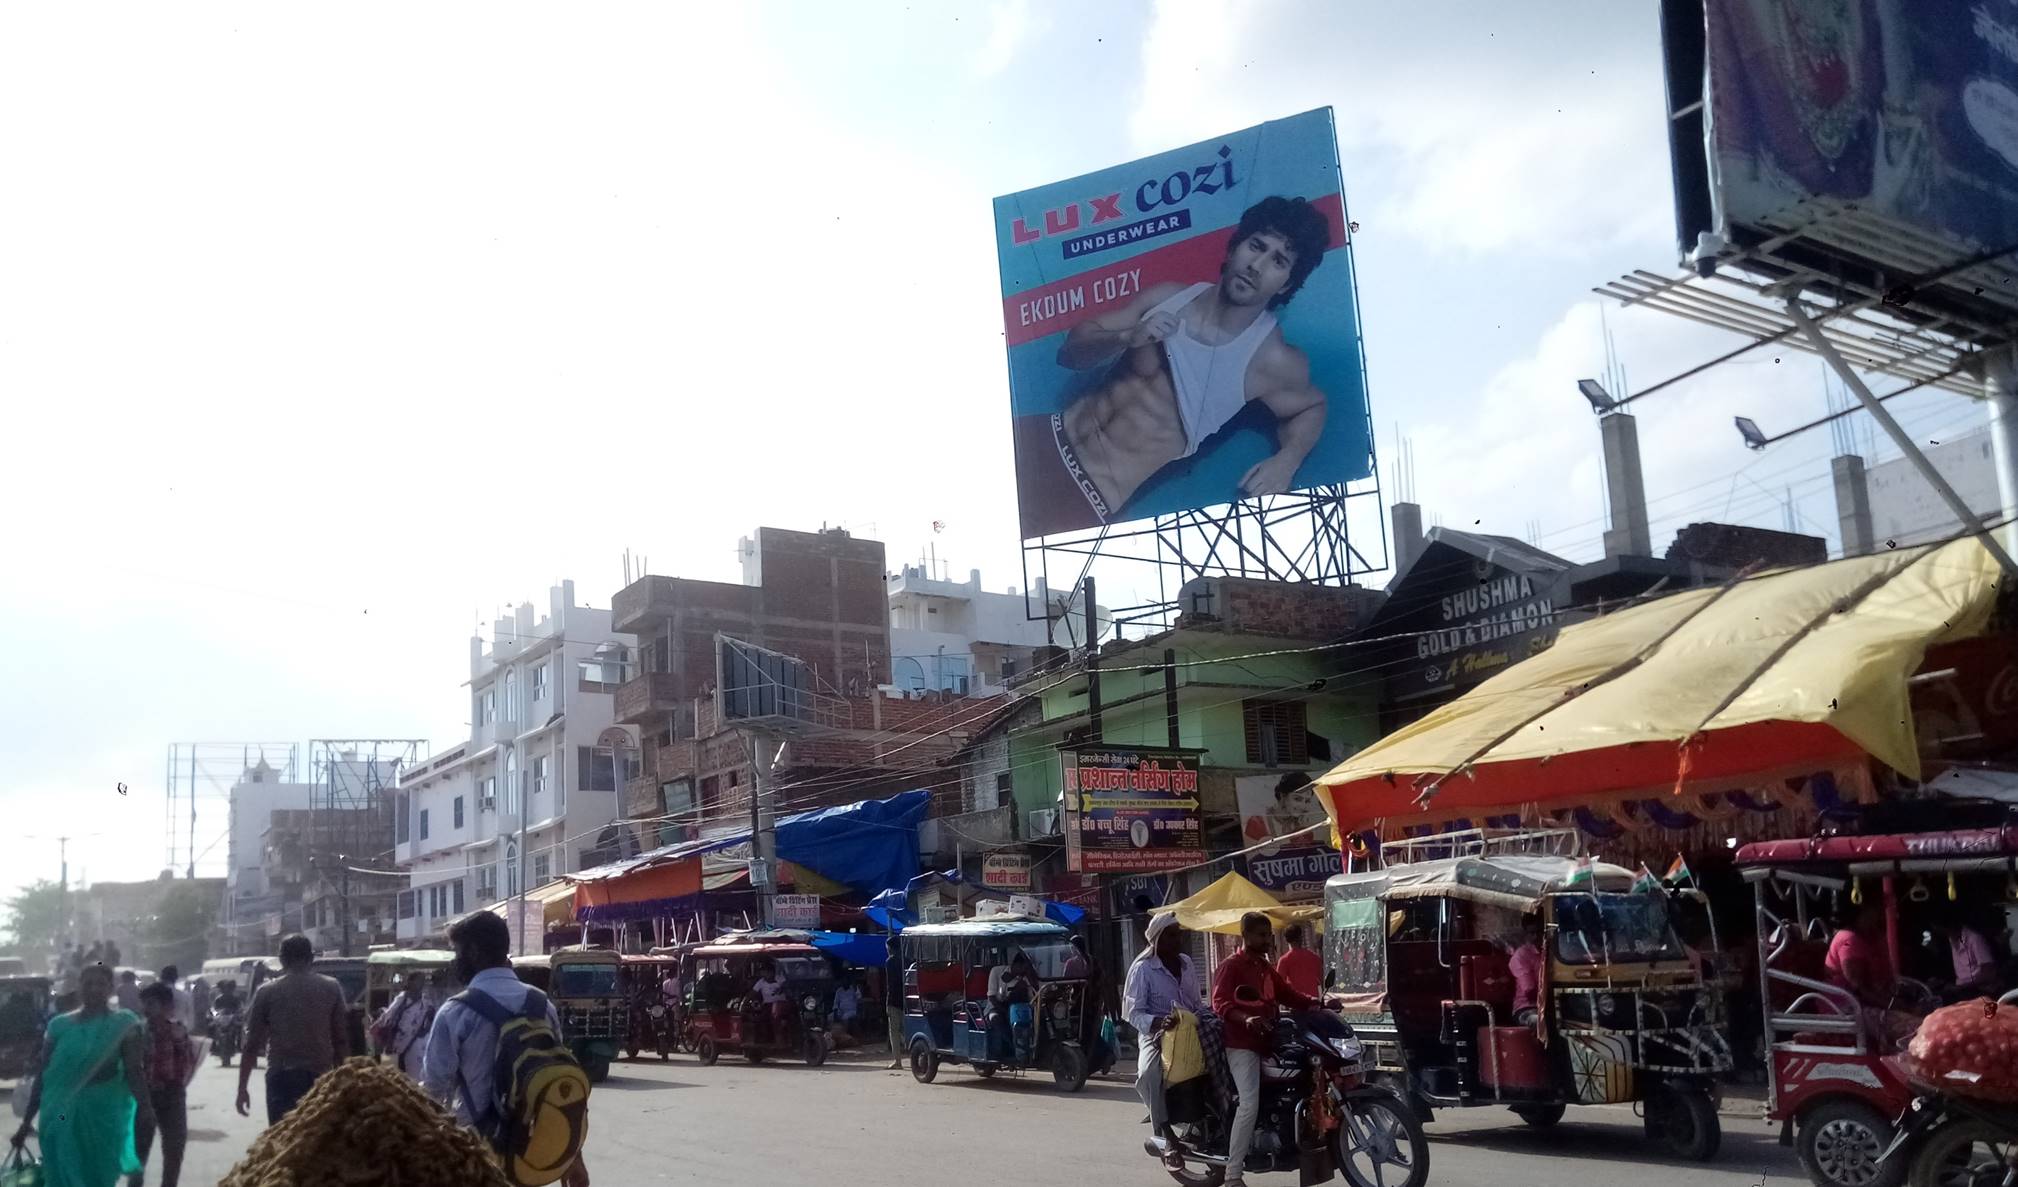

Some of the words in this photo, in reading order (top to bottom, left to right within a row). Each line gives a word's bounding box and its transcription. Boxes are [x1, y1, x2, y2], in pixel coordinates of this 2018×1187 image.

[1011, 192, 1125, 247] LUX
[1070, 215, 1181, 254] UNDERWEAR
[1020, 285, 1086, 327] EKDUM
[1093, 268, 1142, 304] COZY
[1062, 445, 1083, 478] LUX
[1081, 479, 1108, 517] COZI
[1441, 574, 1533, 622] SHUSHMA
[1417, 630, 1461, 660] GOLD
[1465, 621, 1476, 647] &
[1080, 766, 1129, 792] प्रशान्त
[1171, 761, 1198, 796] होम
[1253, 856, 1305, 886] सुषमा
